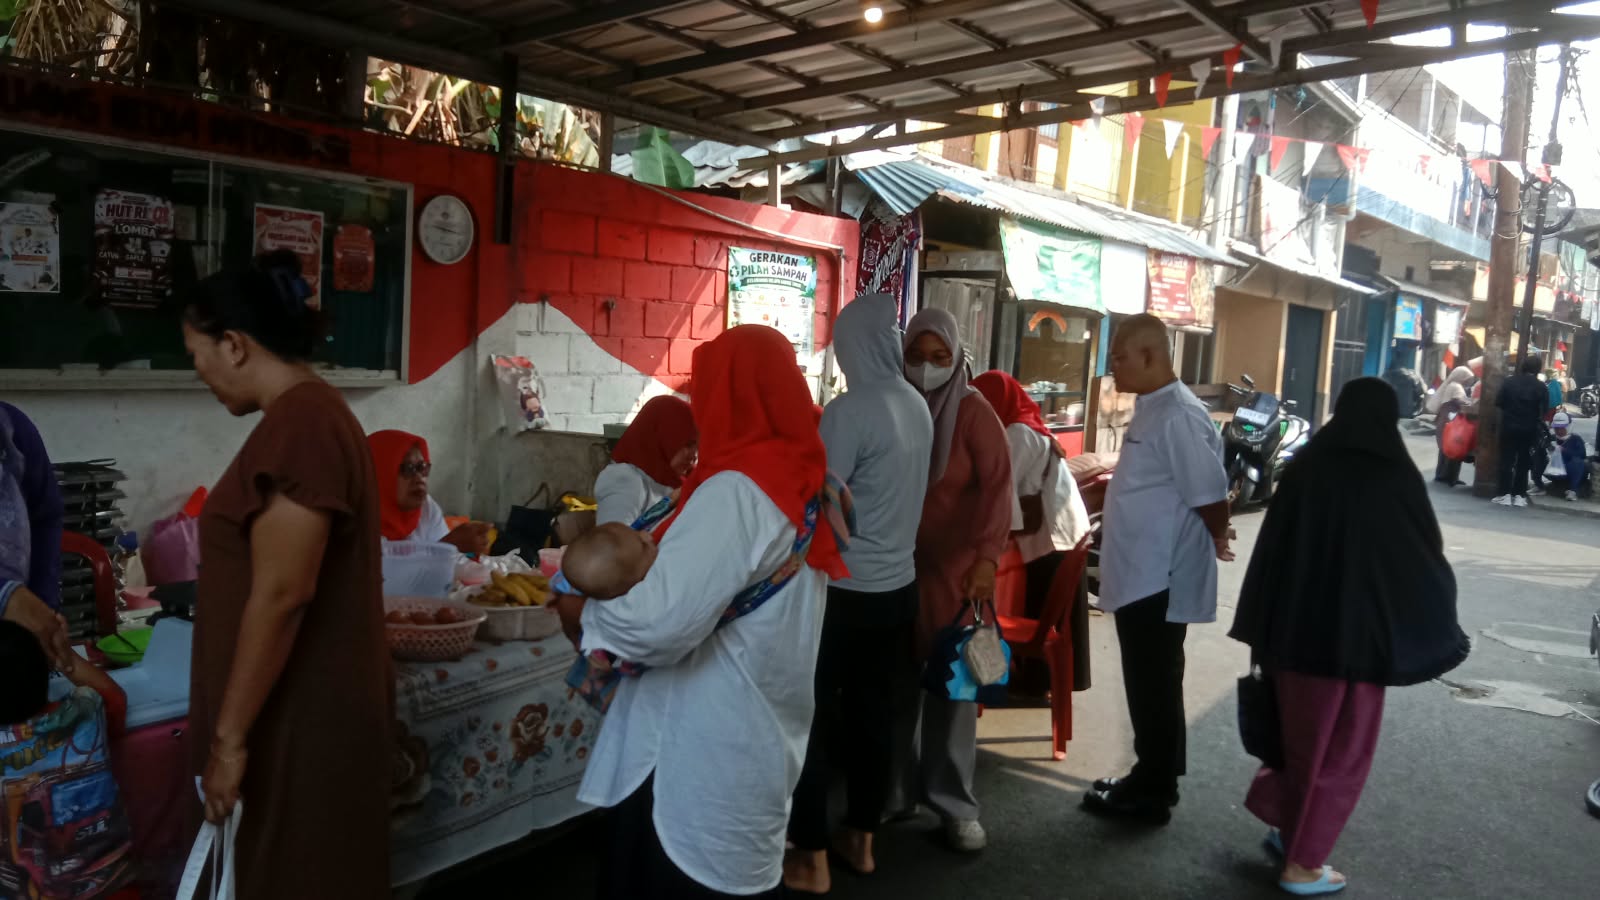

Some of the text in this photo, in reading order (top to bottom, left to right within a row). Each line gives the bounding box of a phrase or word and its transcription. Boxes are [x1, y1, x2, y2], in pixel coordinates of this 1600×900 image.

[106, 204, 131, 217] HUT
[134, 206, 148, 219] RI
[116, 225, 155, 238] LOMBA
[750, 253, 798, 266] GERAKAN
[741, 264, 807, 281] PILAH SAMPAH
